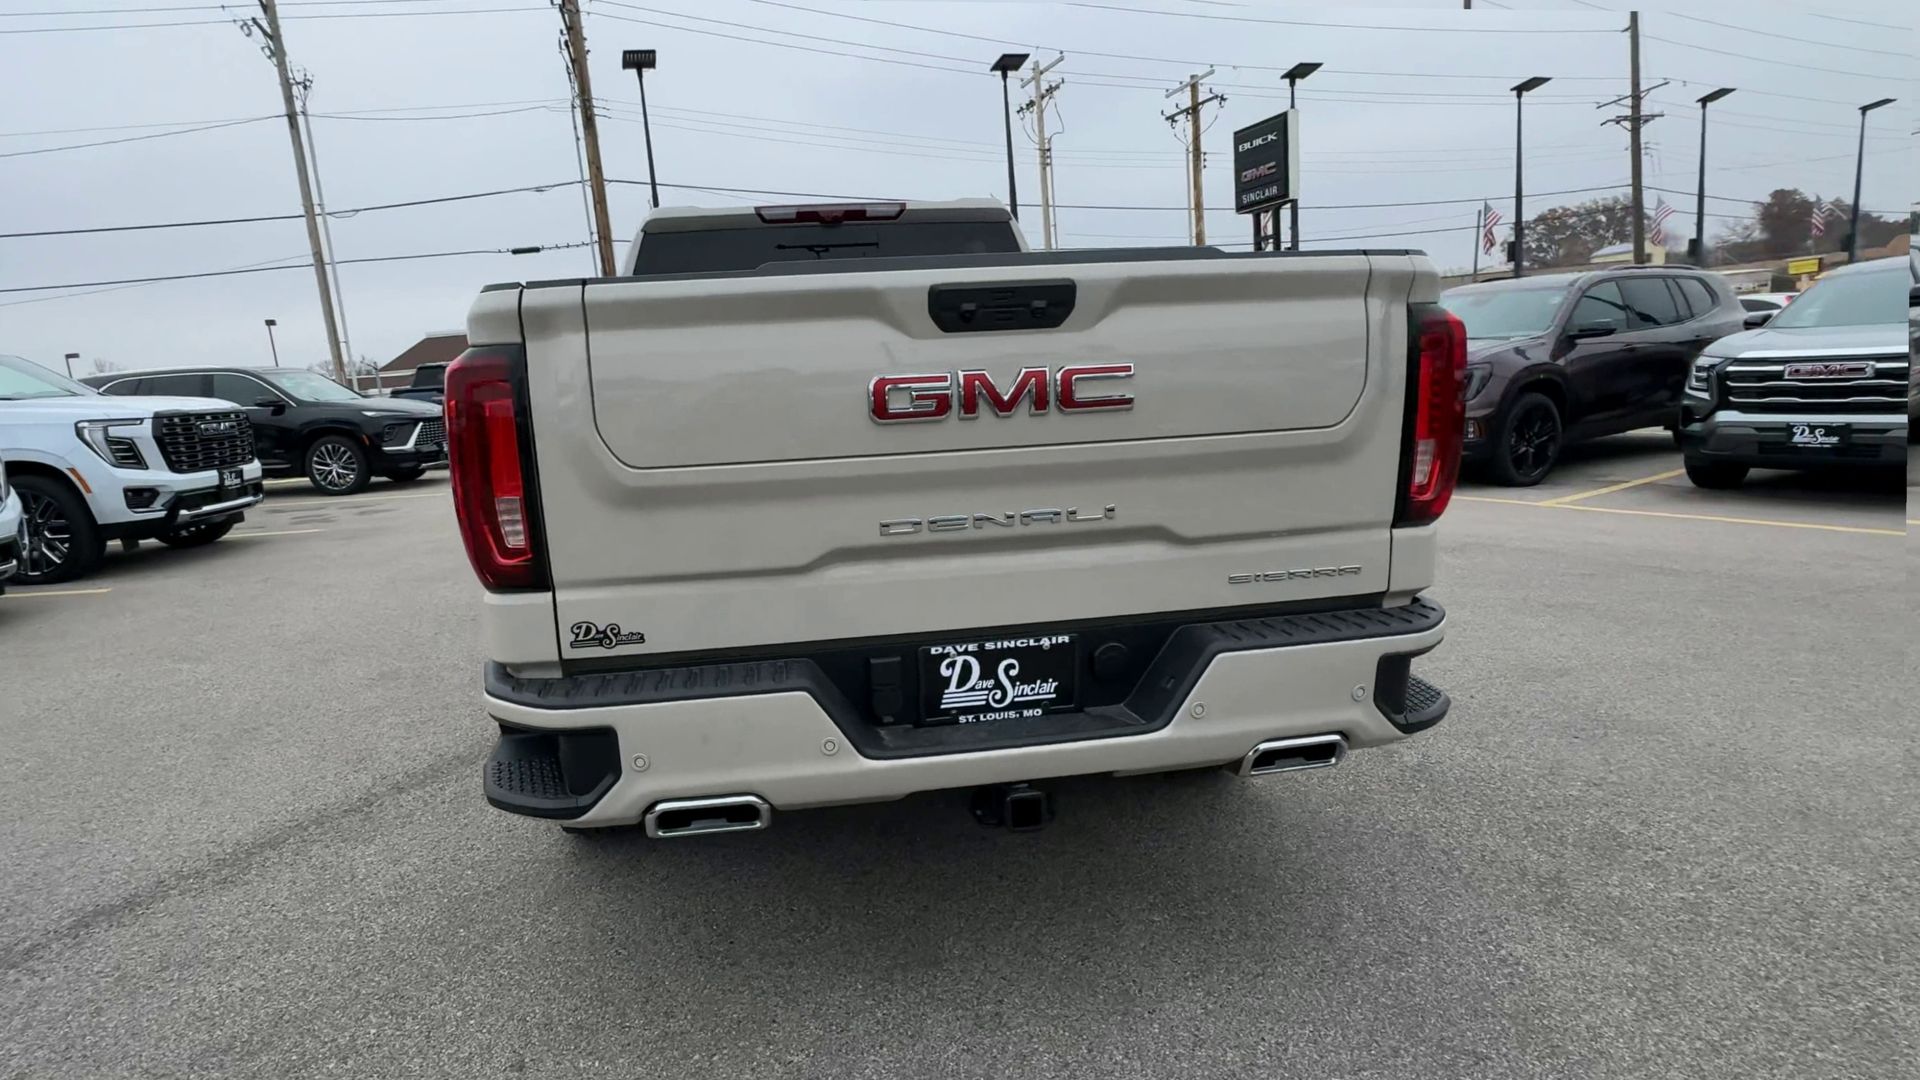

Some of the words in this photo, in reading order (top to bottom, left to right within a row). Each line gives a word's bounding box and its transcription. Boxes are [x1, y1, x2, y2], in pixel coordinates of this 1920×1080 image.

[1238, 131, 1278, 152] BUICK
[1240, 161, 1278, 183] GMC
[1241, 185, 1278, 204] SINCLAIR
[1786, 363, 1868, 377] GMC
[868, 361, 1136, 425] GMC
[879, 503, 1116, 536] DENALI
[1228, 564, 1363, 584] SIERRA
[930, 643, 979, 655] DAVE
[984, 635, 1070, 650] SINCLAIR
[940, 655, 995, 693] Dave
[988, 658, 1059, 708] Sinclair
[958, 715, 977, 724] ST.
[1022, 708, 1043, 718] MO
